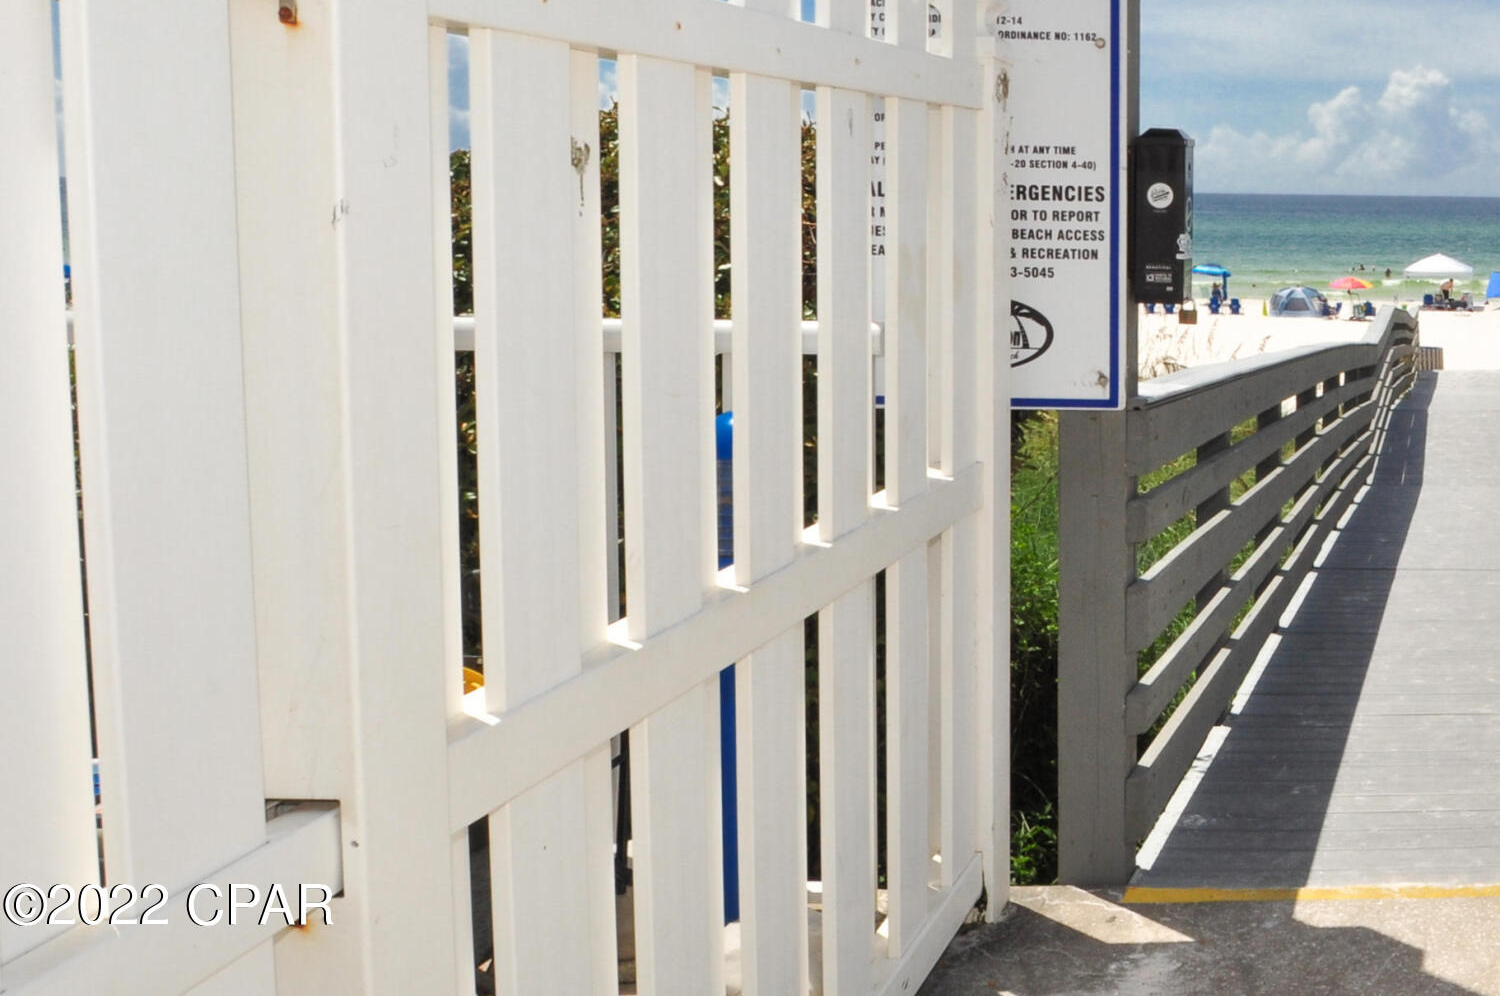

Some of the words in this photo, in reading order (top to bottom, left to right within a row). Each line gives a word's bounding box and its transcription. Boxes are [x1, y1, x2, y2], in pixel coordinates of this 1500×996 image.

[998, 31, 1051, 41] ORDINANCE
[1055, 32, 1070, 41] NO:
[1075, 33, 1096, 42] 1162
[1018, 145, 1029, 154] AT
[1033, 146, 1050, 154] ANY
[1054, 146, 1076, 155] TIME
[1029, 160, 1068, 169] SECTION
[1010, 184, 1105, 202] RGENCIES
[1011, 210, 1027, 221] OR
[1032, 210, 1047, 221] TO
[1052, 210, 1100, 222] REPORT
[1012, 229, 1052, 240] BEACH
[1057, 230, 1105, 241] ACCESS
[1022, 248, 1098, 260] RECREATION
